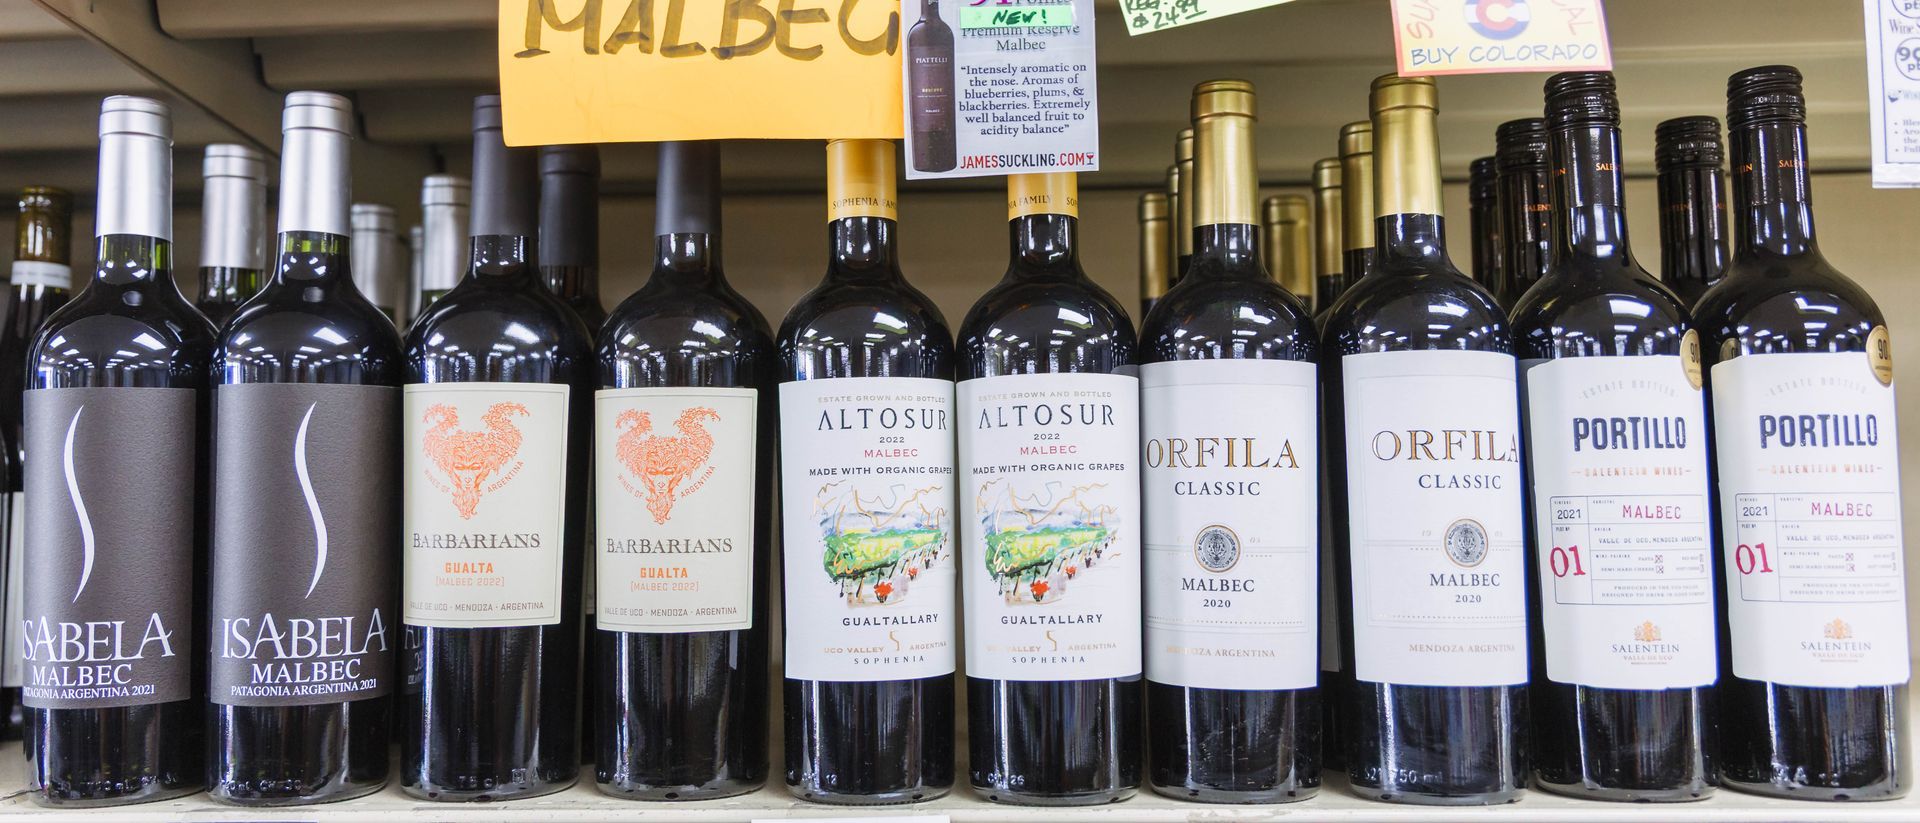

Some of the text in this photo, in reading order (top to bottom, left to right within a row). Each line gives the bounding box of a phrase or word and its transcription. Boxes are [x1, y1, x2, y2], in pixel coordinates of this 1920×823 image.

[963, 26, 1022, 37] Premium
[996, 39, 1046, 51] Malbec
[1411, 44, 1598, 66] BUY COLORADO
[1021, 63, 1069, 74] aromatic
[969, 77, 986, 87] the
[1022, 76, 1064, 85] Aromas
[1067, 74, 1079, 84] of
[964, 87, 1085, 99] blueberries, plums, &
[959, 98, 1091, 112] blackberries. Extremely
[965, 109, 1085, 123] well balanced fruit to
[980, 125, 1020, 137] acidity
[960, 152, 1085, 169] JAMESSUCKLING.COM
[832, 197, 879, 210] SOPHENIA
[818, 395, 852, 403] ESTATE
[916, 396, 945, 404] BOTTLED
[978, 393, 1008, 402] ESTATE
[1011, 391, 1046, 399] GROWN
[817, 407, 947, 431] ALTOSUR
[979, 403, 1115, 430] ALTOSUR
[1033, 433, 1061, 441] 2022
[1572, 416, 1687, 452] PORTILLO
[1759, 414, 1878, 449] PORTILLO
[879, 436, 905, 444] 2022
[1372, 429, 1519, 463] ORFILA
[864, 448, 918, 458] MALBEC
[1020, 445, 1077, 456] MALBEC
[1146, 437, 1300, 469] ORFILA
[809, 466, 952, 476] MADE WITH ORGANIC GRAPES
[973, 463, 1125, 475] MADE WITH ORGANIC GRAPES
[487, 460, 525, 494] ARGENTINA
[681, 465, 716, 498] ARGENTINA
[1418, 474, 1501, 489] CLASSIC
[1174, 481, 1261, 496] CLASSIC
[1557, 509, 1581, 520] 2021
[1622, 504, 1681, 519] MALBEC
[1743, 506, 1768, 517] 2021
[1811, 502, 1873, 517] MALBEC
[412, 533, 541, 549] BARBARIANS
[606, 538, 733, 553] BARBARIANS
[1550, 545, 1586, 578] 01
[1735, 543, 1774, 575] 01
[445, 562, 494, 574] GUALTA
[640, 567, 688, 579] GUALTA
[1181, 578, 1255, 593] MALBEC
[1429, 573, 1500, 587] MALBEC
[1203, 598, 1231, 608] 2020
[1455, 594, 1482, 603] 2020
[455, 603, 493, 612] MENDOZA
[500, 602, 544, 611] ARGENTINA
[629, 608, 644, 617] UCO
[650, 608, 688, 617] MENDOZA
[695, 607, 737, 616] ARGENTINA
[842, 613, 939, 627] GUALTALLARY
[1001, 614, 1103, 625] GUALTALLARY
[221, 607, 388, 660] ISABELA
[909, 641, 948, 651] ARGENTINA
[1068, 642, 1117, 652] ARGENTINA
[1409, 643, 1515, 653] MENDOZA ARGENTINA
[1612, 644, 1680, 653] SALENTEIN
[1801, 641, 1872, 651] SALENTEIN
[1214, 648, 1276, 657] ARGENTINA
[854, 655, 925, 664] SOPHENIA
[1012, 656, 1086, 664] SOPHENIA
[32, 663, 132, 687] MALBEC
[252, 658, 361, 684] MALBEC
[60, 686, 130, 699] ARGENTINA
[132, 684, 155, 696] 2021
[231, 678, 377, 697] PATAGONIA ARGENTINA 2021
